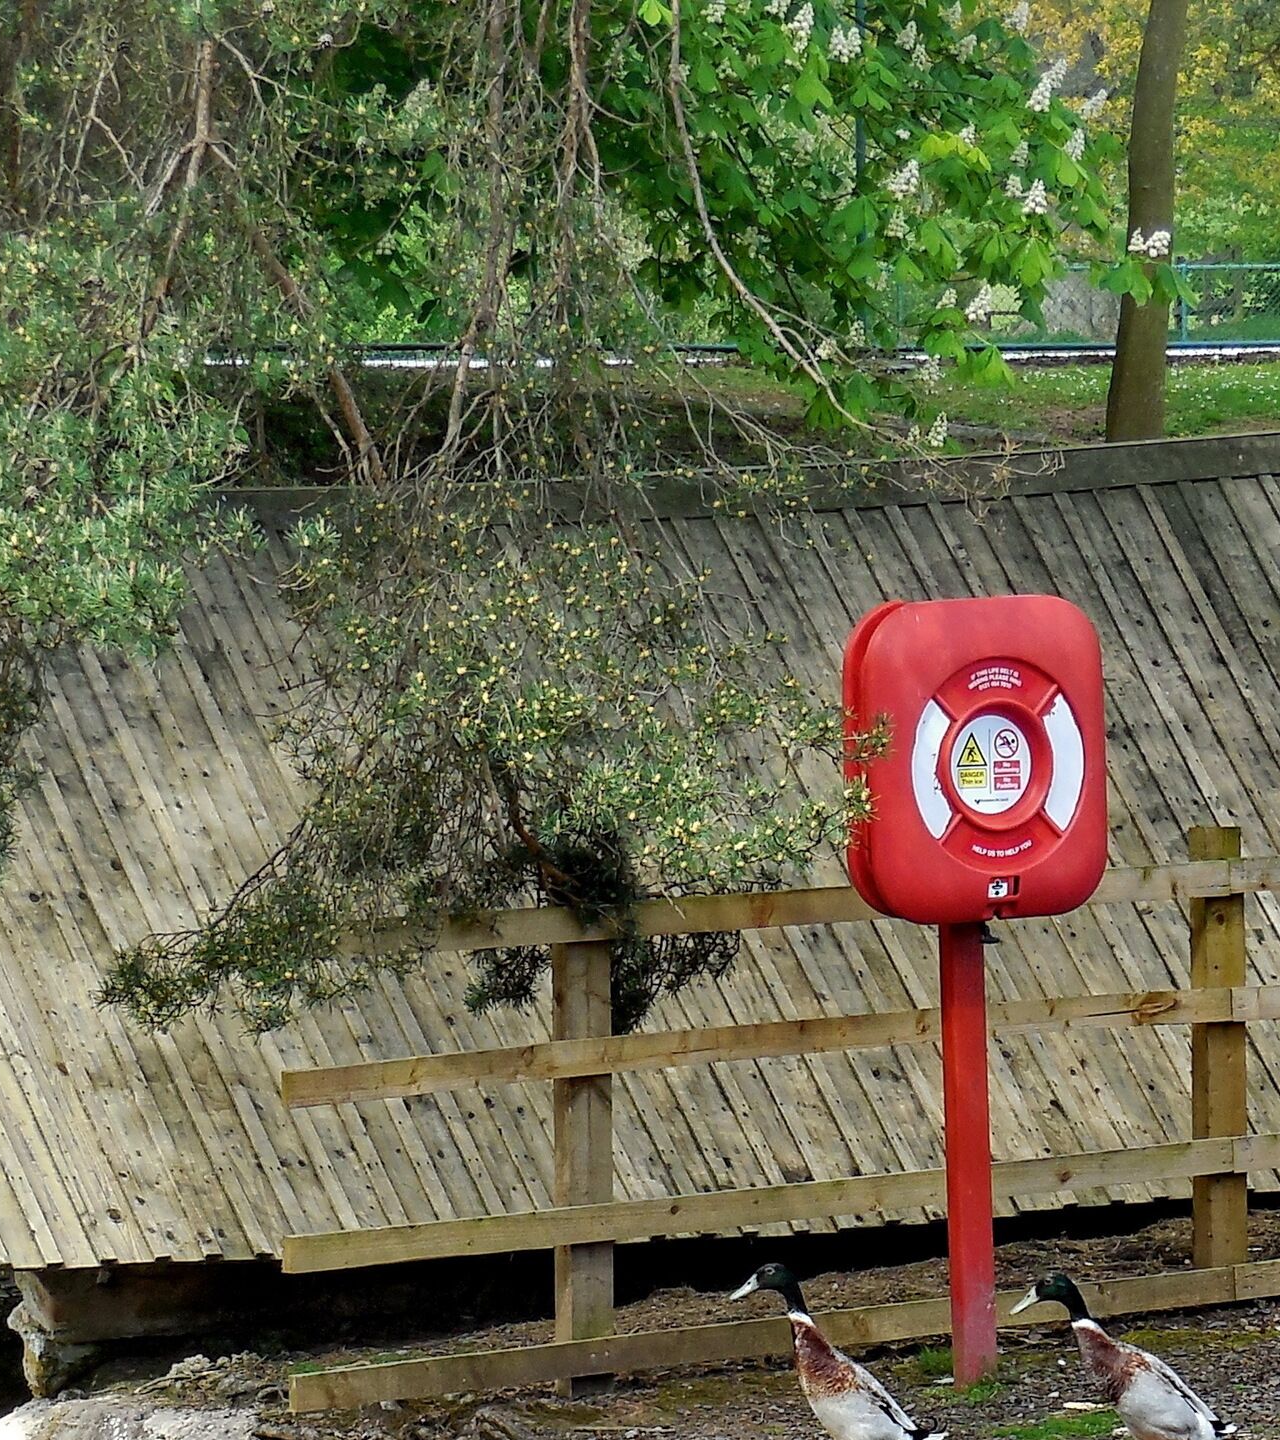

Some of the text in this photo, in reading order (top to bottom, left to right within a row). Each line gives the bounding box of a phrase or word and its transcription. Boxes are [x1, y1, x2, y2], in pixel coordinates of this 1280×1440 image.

[976, 669, 987, 677] THIS
[1000, 667, 1013, 675] BELT
[972, 839, 1032, 857] HELP US TO HELP YOU
